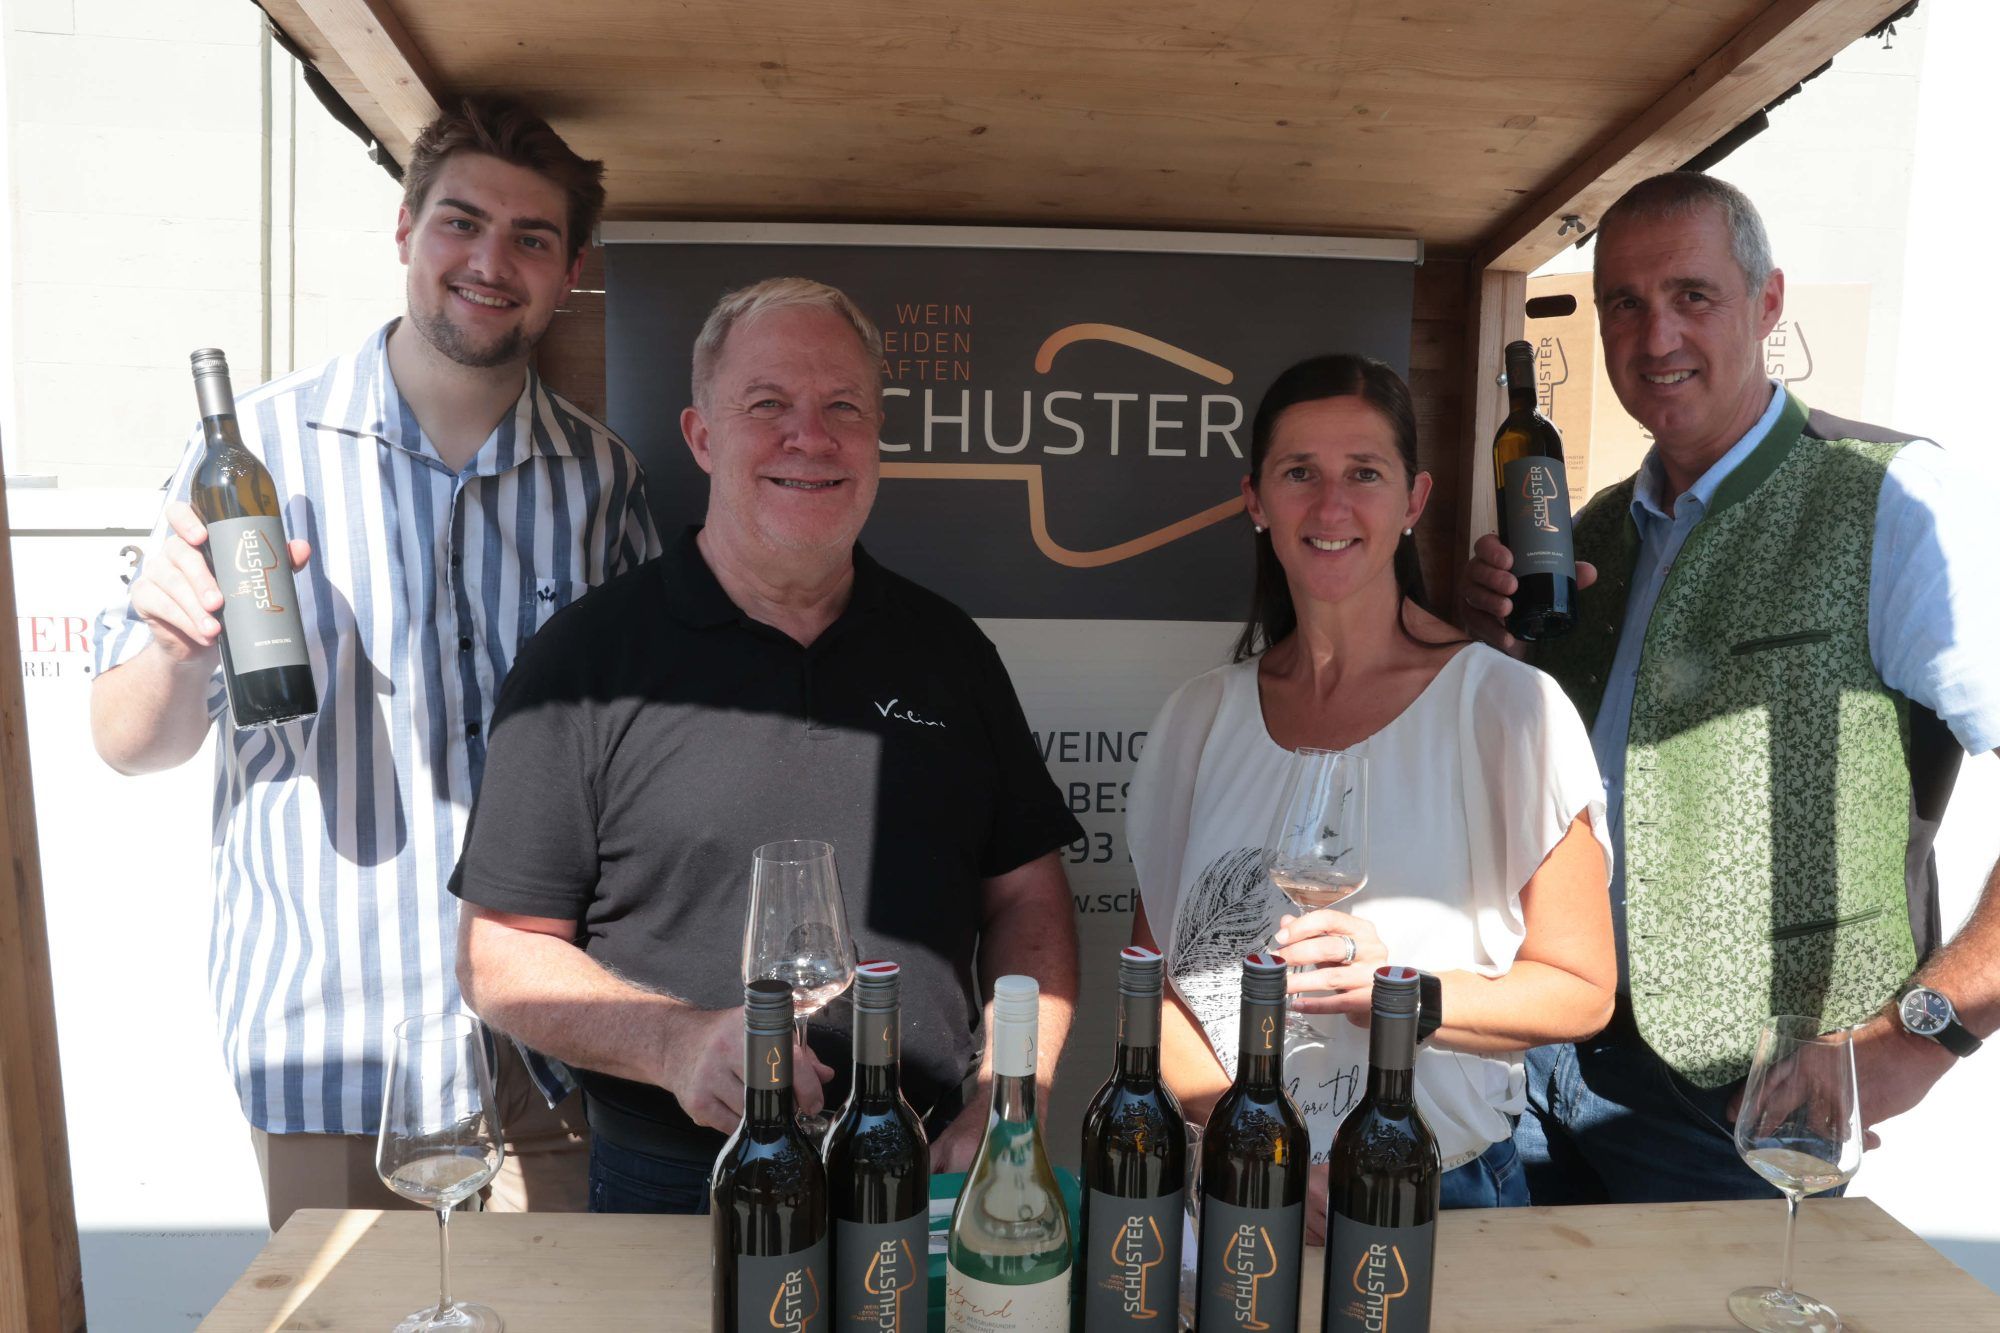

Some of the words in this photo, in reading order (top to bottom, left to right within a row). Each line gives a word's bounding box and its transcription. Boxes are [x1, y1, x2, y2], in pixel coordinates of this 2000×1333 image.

[884, 332, 970, 353] EIDEN
[896, 303, 971, 325] WEIN
[1539, 336, 1553, 416] CHUSTER
[879, 387, 1244, 458] CHUSTER
[1531, 466, 1546, 527] SCHUSTER
[242, 529, 271, 610] SCHUSTER
[17, 616, 90, 653] ER
[1060, 832, 1114, 864] 93
[1124, 1216, 1144, 1312] SCHUSTER
[1235, 1224, 1256, 1322] SCHUSTER
[1365, 1244, 1387, 1333] CHUSTER
